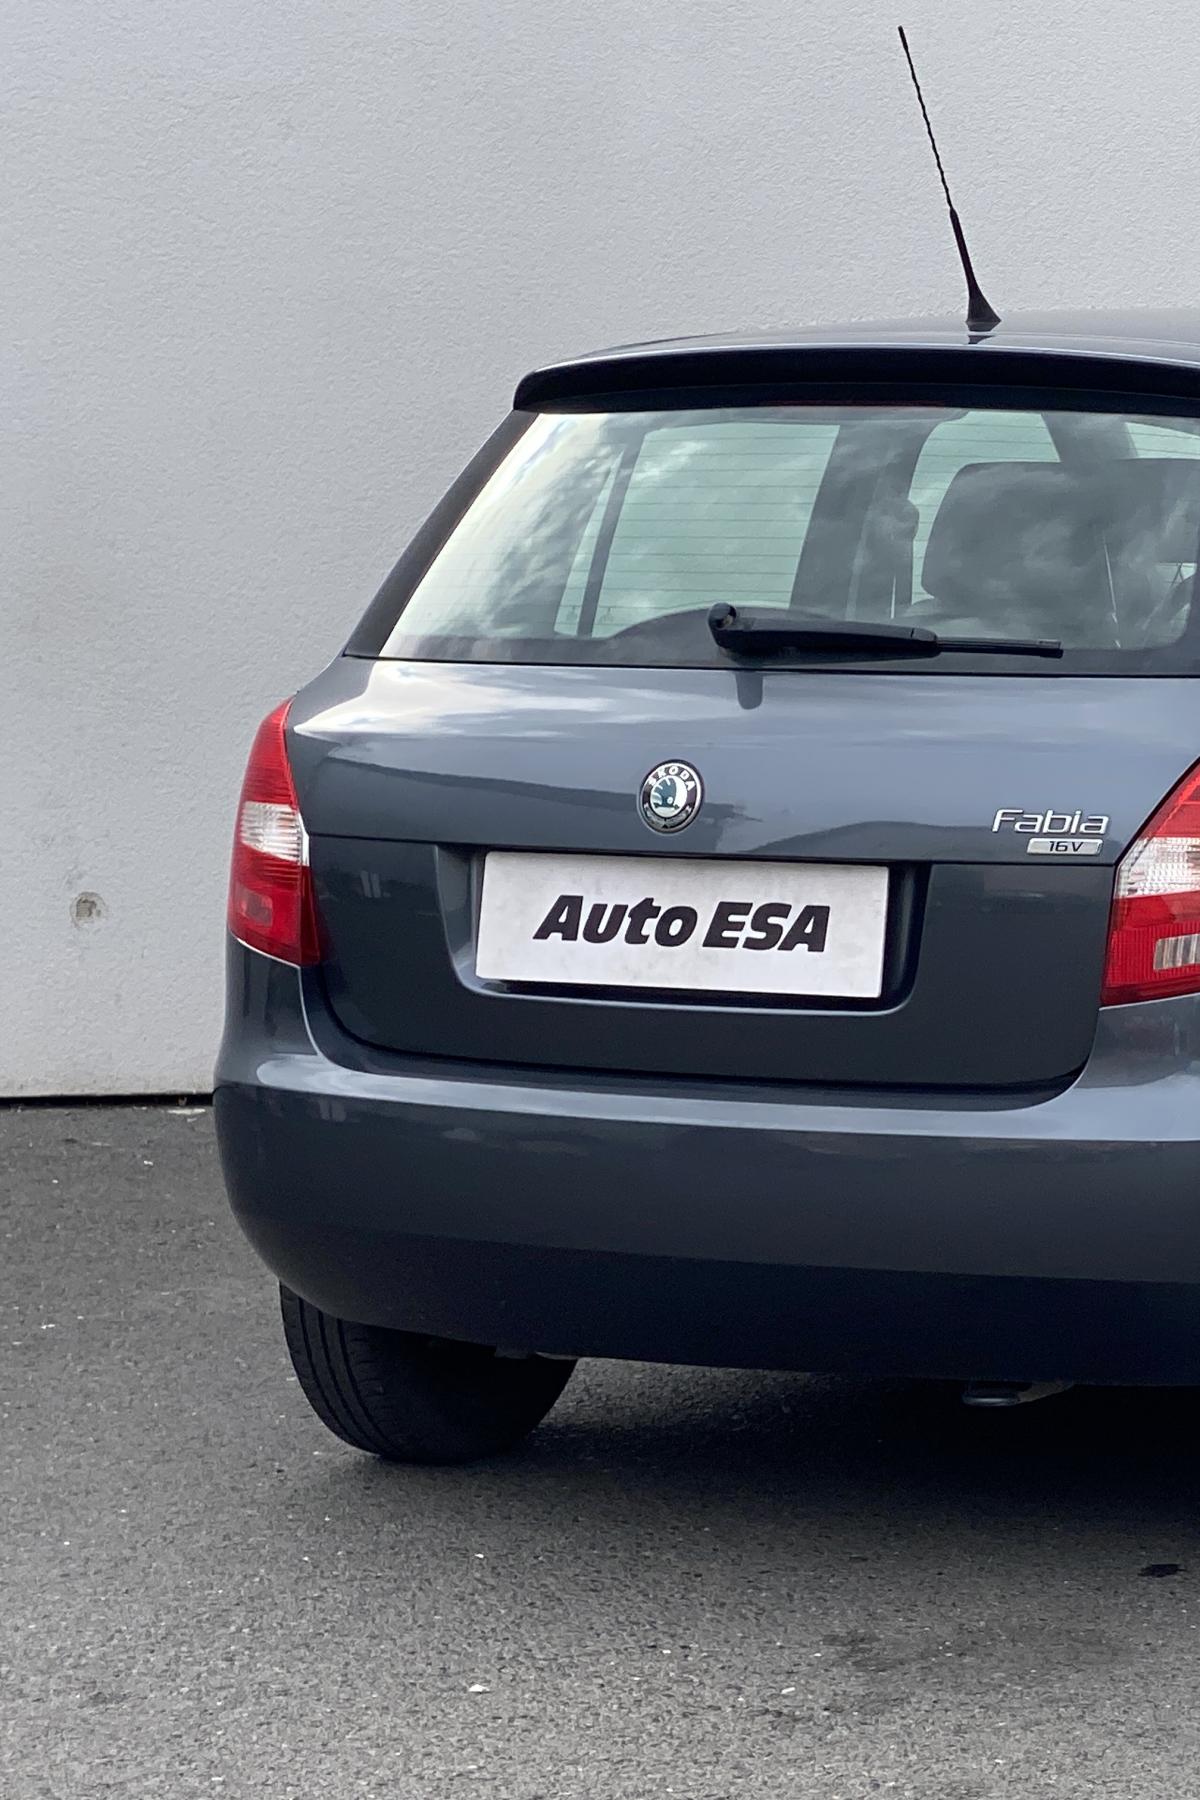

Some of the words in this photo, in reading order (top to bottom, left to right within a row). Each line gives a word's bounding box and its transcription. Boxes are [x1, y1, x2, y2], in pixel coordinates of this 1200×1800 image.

[991, 808, 1110, 834] Fabia
[533, 894, 698, 947] Auto
[702, 900, 831, 952] ESA
